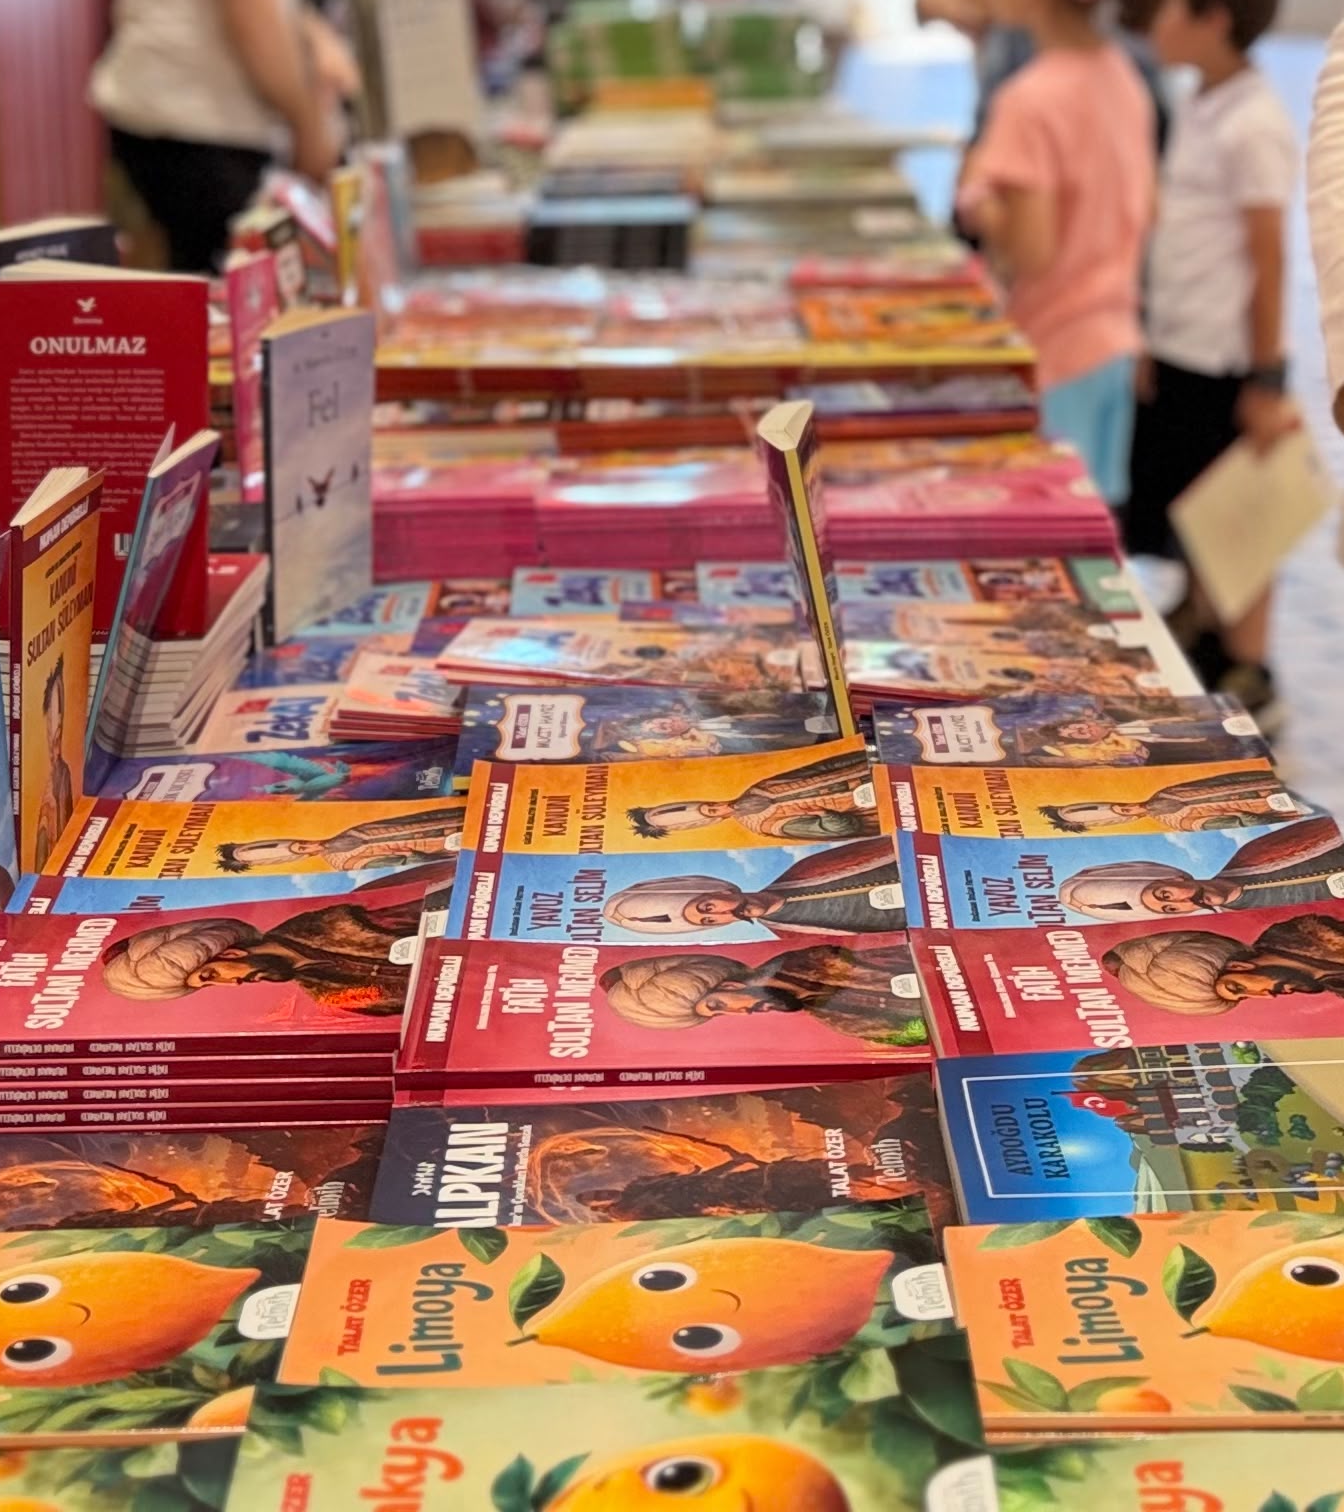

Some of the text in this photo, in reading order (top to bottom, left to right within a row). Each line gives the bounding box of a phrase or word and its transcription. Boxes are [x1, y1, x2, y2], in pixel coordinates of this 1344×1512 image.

[29, 336, 147, 356] ONULMAZ
[307, 381, 340, 430] Fel
[39, 521, 60, 551] NUMAN
[49, 556, 77, 608] KANUNİ
[26, 616, 56, 667] SULTAN
[57, 583, 93, 637] SÜLEYMAN
[486, 782, 509, 825] DEMİRELLİ
[542, 794, 571, 837] KANUNİ
[575, 765, 609, 822] SÜLEYMAN
[947, 792, 983, 829] KANUNİ
[984, 769, 1019, 818] SÜLEYMAN
[125, 829, 168, 869] KANUNİ
[167, 803, 216, 855] SÜLEYMAN
[470, 871, 495, 918] DEMİRELLİ
[567, 869, 607, 903] SELİM
[916, 854, 945, 902] DEMİRELLİ
[1012, 854, 1056, 890] SELİM
[527, 891, 564, 931] YAVUZ
[982, 877, 1021, 917] YAVUZ
[24, 918, 117, 1029] SULTAN MEHMED
[499, 978, 549, 1013] FATİH
[928, 945, 981, 1032] NUMAN DEMİRELLİ
[1007, 966, 1064, 1001] FATİH
[1046, 930, 1133, 1049] SULTAN MEHMED
[425, 955, 462, 1042] NUMAN DEMİRELLİ
[547, 946, 599, 1058] SULTAN MEHMED
[824, 1128, 851, 1198] TALAT ÖZER
[871, 1138, 908, 1185] Telmih
[991, 1103, 1033, 1176] AYDOĞDU
[1024, 1098, 1071, 1180] KARAKOLU
[260, 1171, 295, 1222] LAT ÖZER
[310, 1181, 346, 1217] elmih
[337, 1279, 372, 1356] TALAT ÖZER
[376, 1263, 494, 1376] Limoya
[998, 1278, 1035, 1349] TALAT ÖZER
[1057, 1257, 1149, 1365] Limoya
